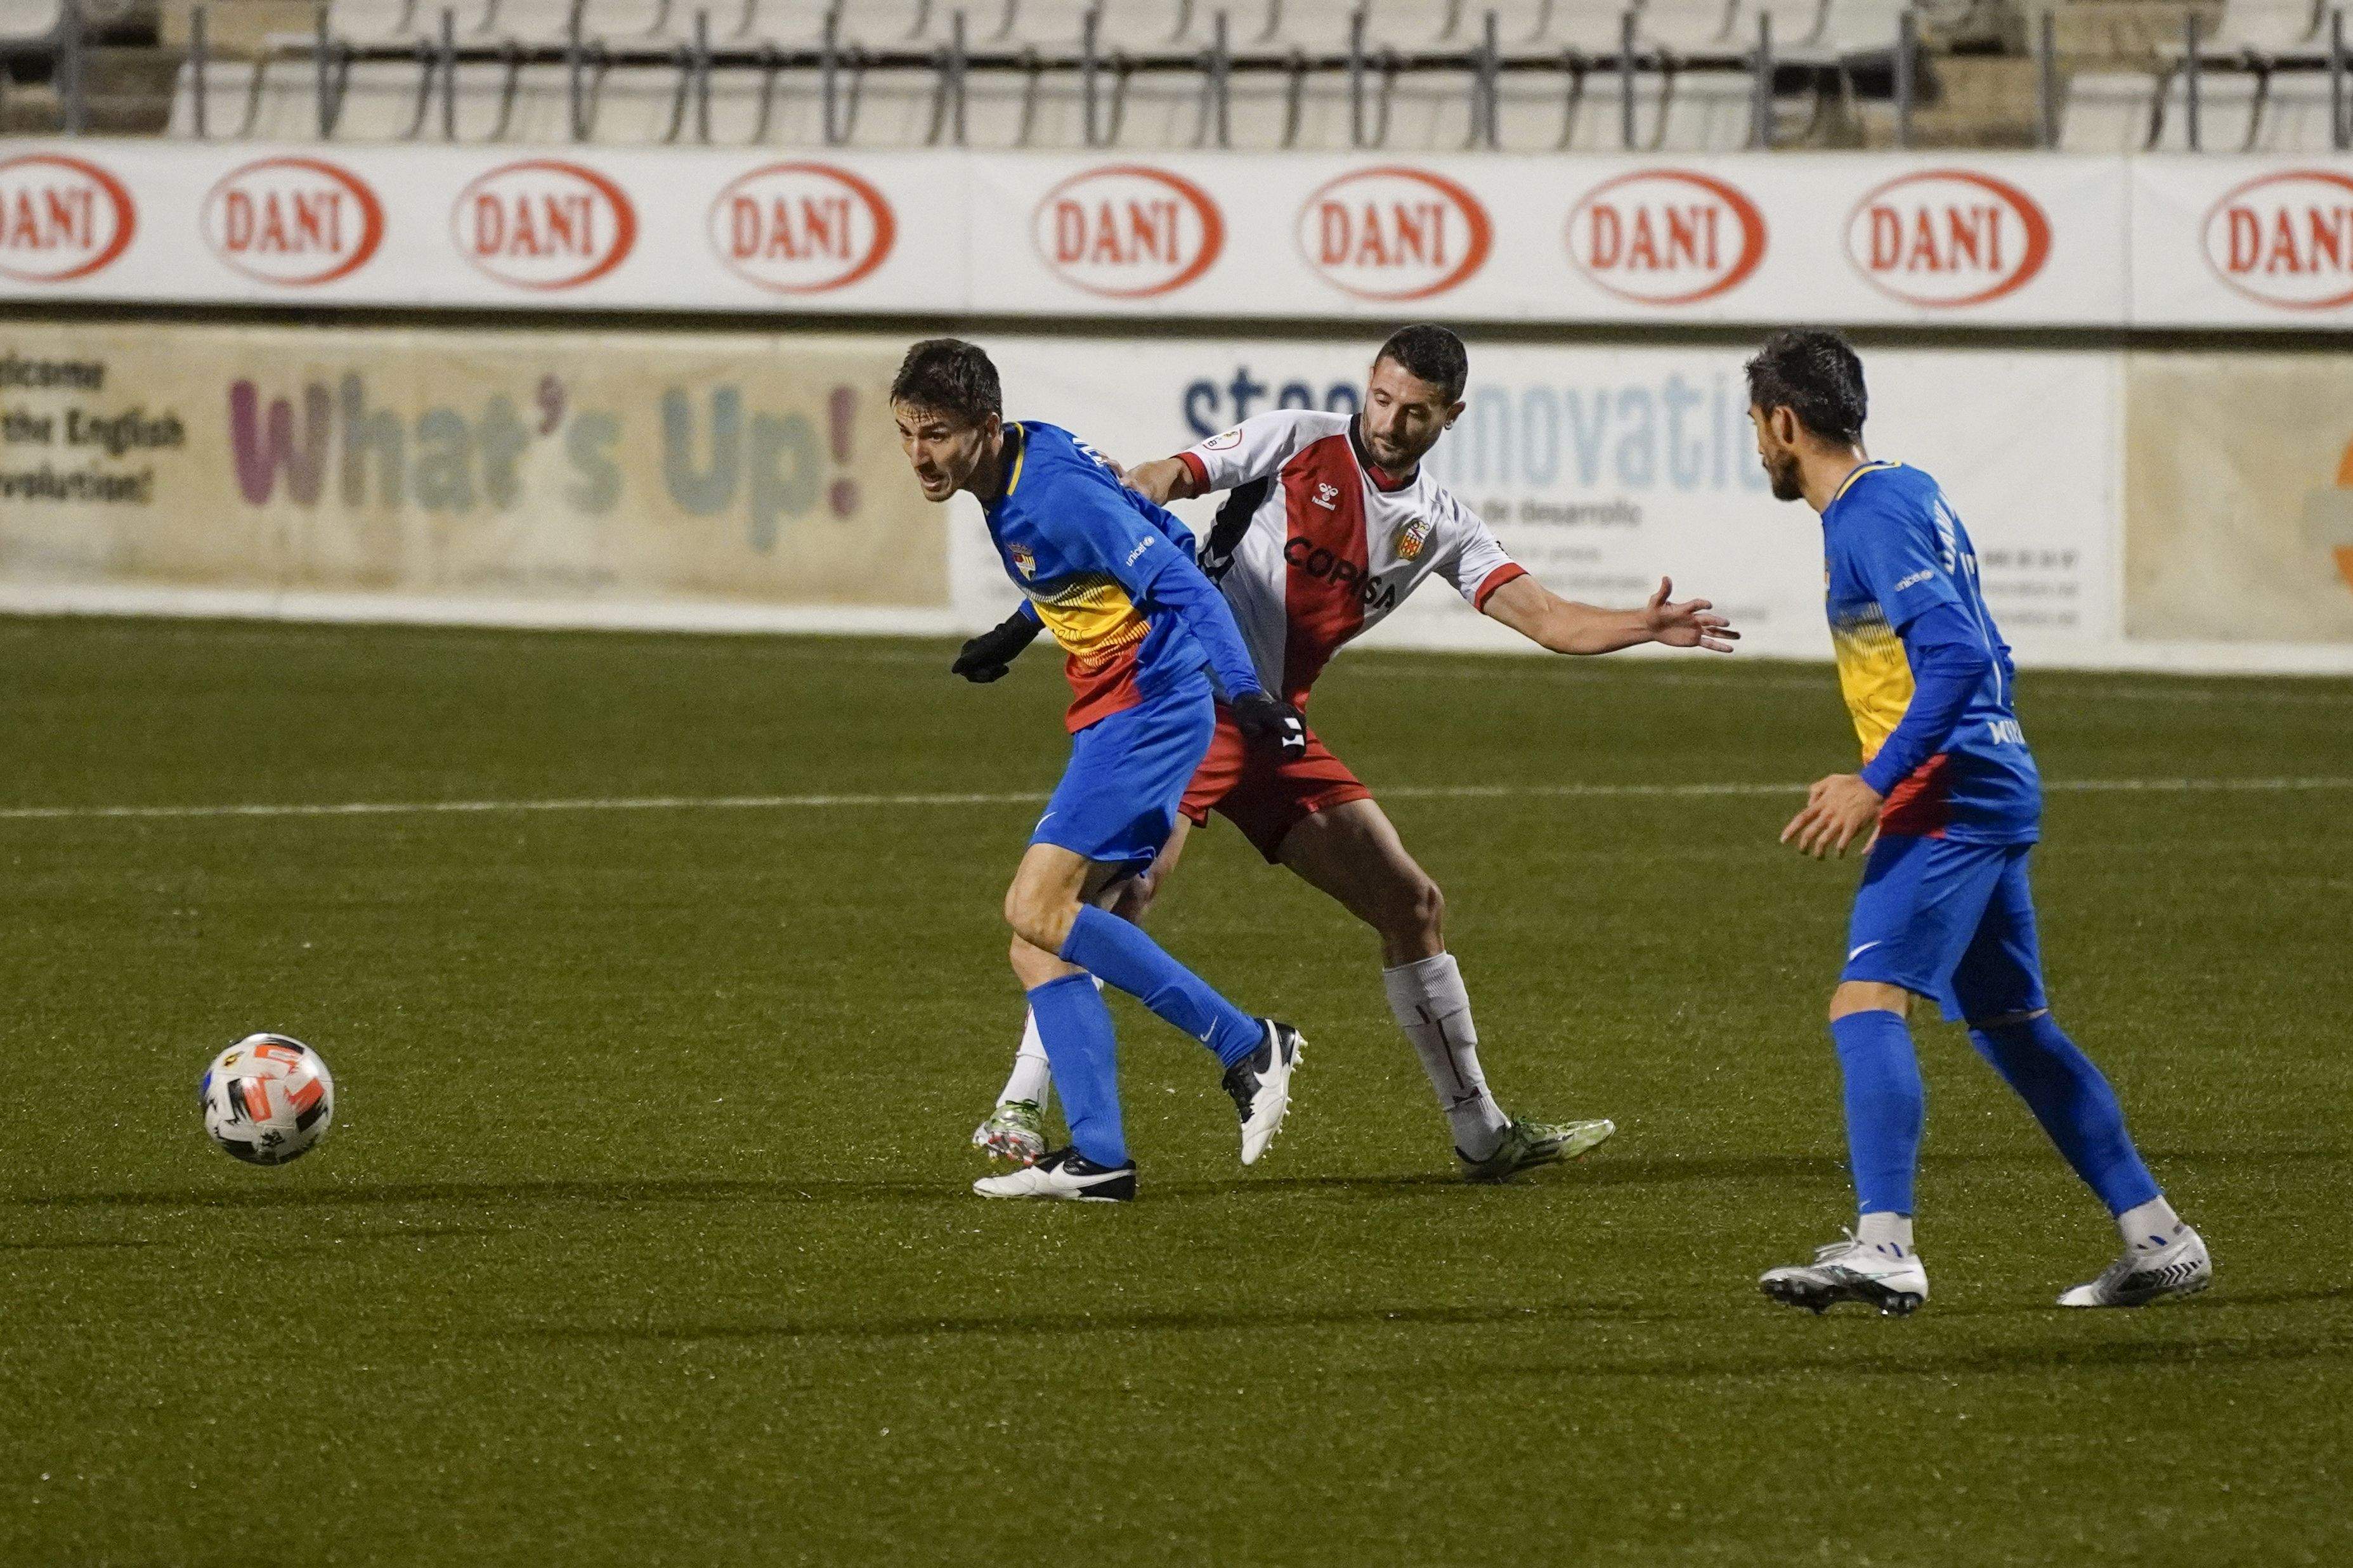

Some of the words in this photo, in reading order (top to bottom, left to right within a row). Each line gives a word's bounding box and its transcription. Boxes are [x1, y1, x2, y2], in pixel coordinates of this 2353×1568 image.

[0, 189, 95, 249] ANI
[225, 190, 341, 252] DANI
[474, 193, 594, 256] DANI
[731, 195, 851, 259] DANI
[1054, 200, 1180, 264] DANI
[1320, 200, 1446, 266] DANI
[1590, 203, 1719, 270] DANI
[1869, 205, 2004, 273] DANI
[230, 370, 622, 512] What's
[662, 384, 857, 553] Up!
